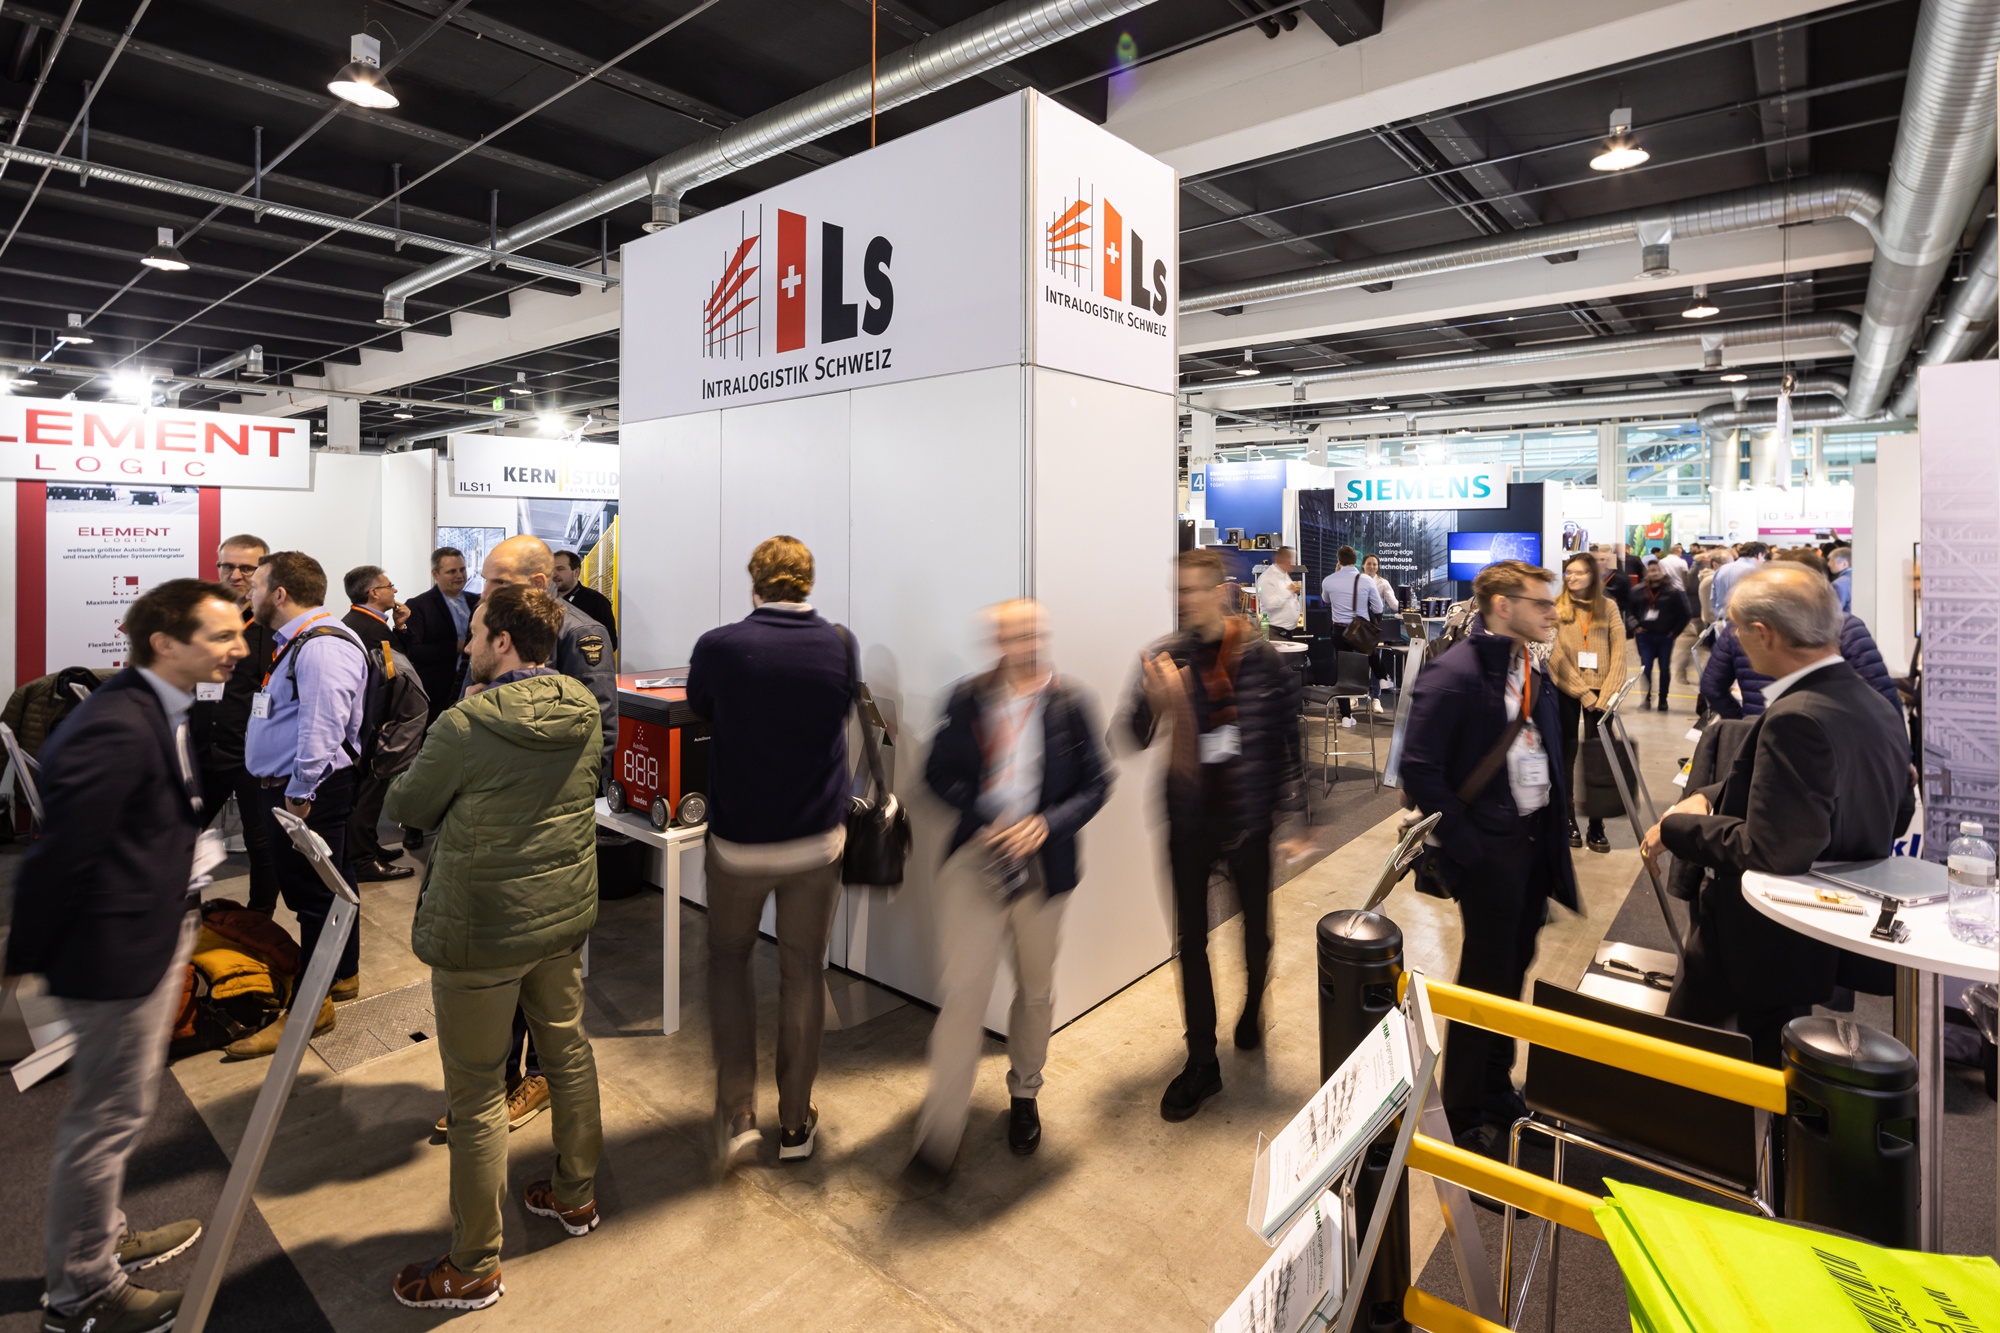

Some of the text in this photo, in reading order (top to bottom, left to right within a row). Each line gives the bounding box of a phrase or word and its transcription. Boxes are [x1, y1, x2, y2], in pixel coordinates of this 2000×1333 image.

[1045, 285, 1167, 338] INTRALOGISTIK SCHWEIZ
[702, 348, 892, 400] INTRALOGISTIK SCHWEIZ
[35, 453, 206, 477] LOGIC
[503, 466, 556, 484] KERN
[1193, 474, 1205, 490] 4
[459, 482, 492, 492] ILS11
[1346, 474, 1491, 502] SIEMENS
[78, 526, 171, 537] ELEMENT
[1378, 548, 1414, 556] cutting-edge
[1379, 564, 1418, 572] technologies
[624, 749, 658, 790] 888
